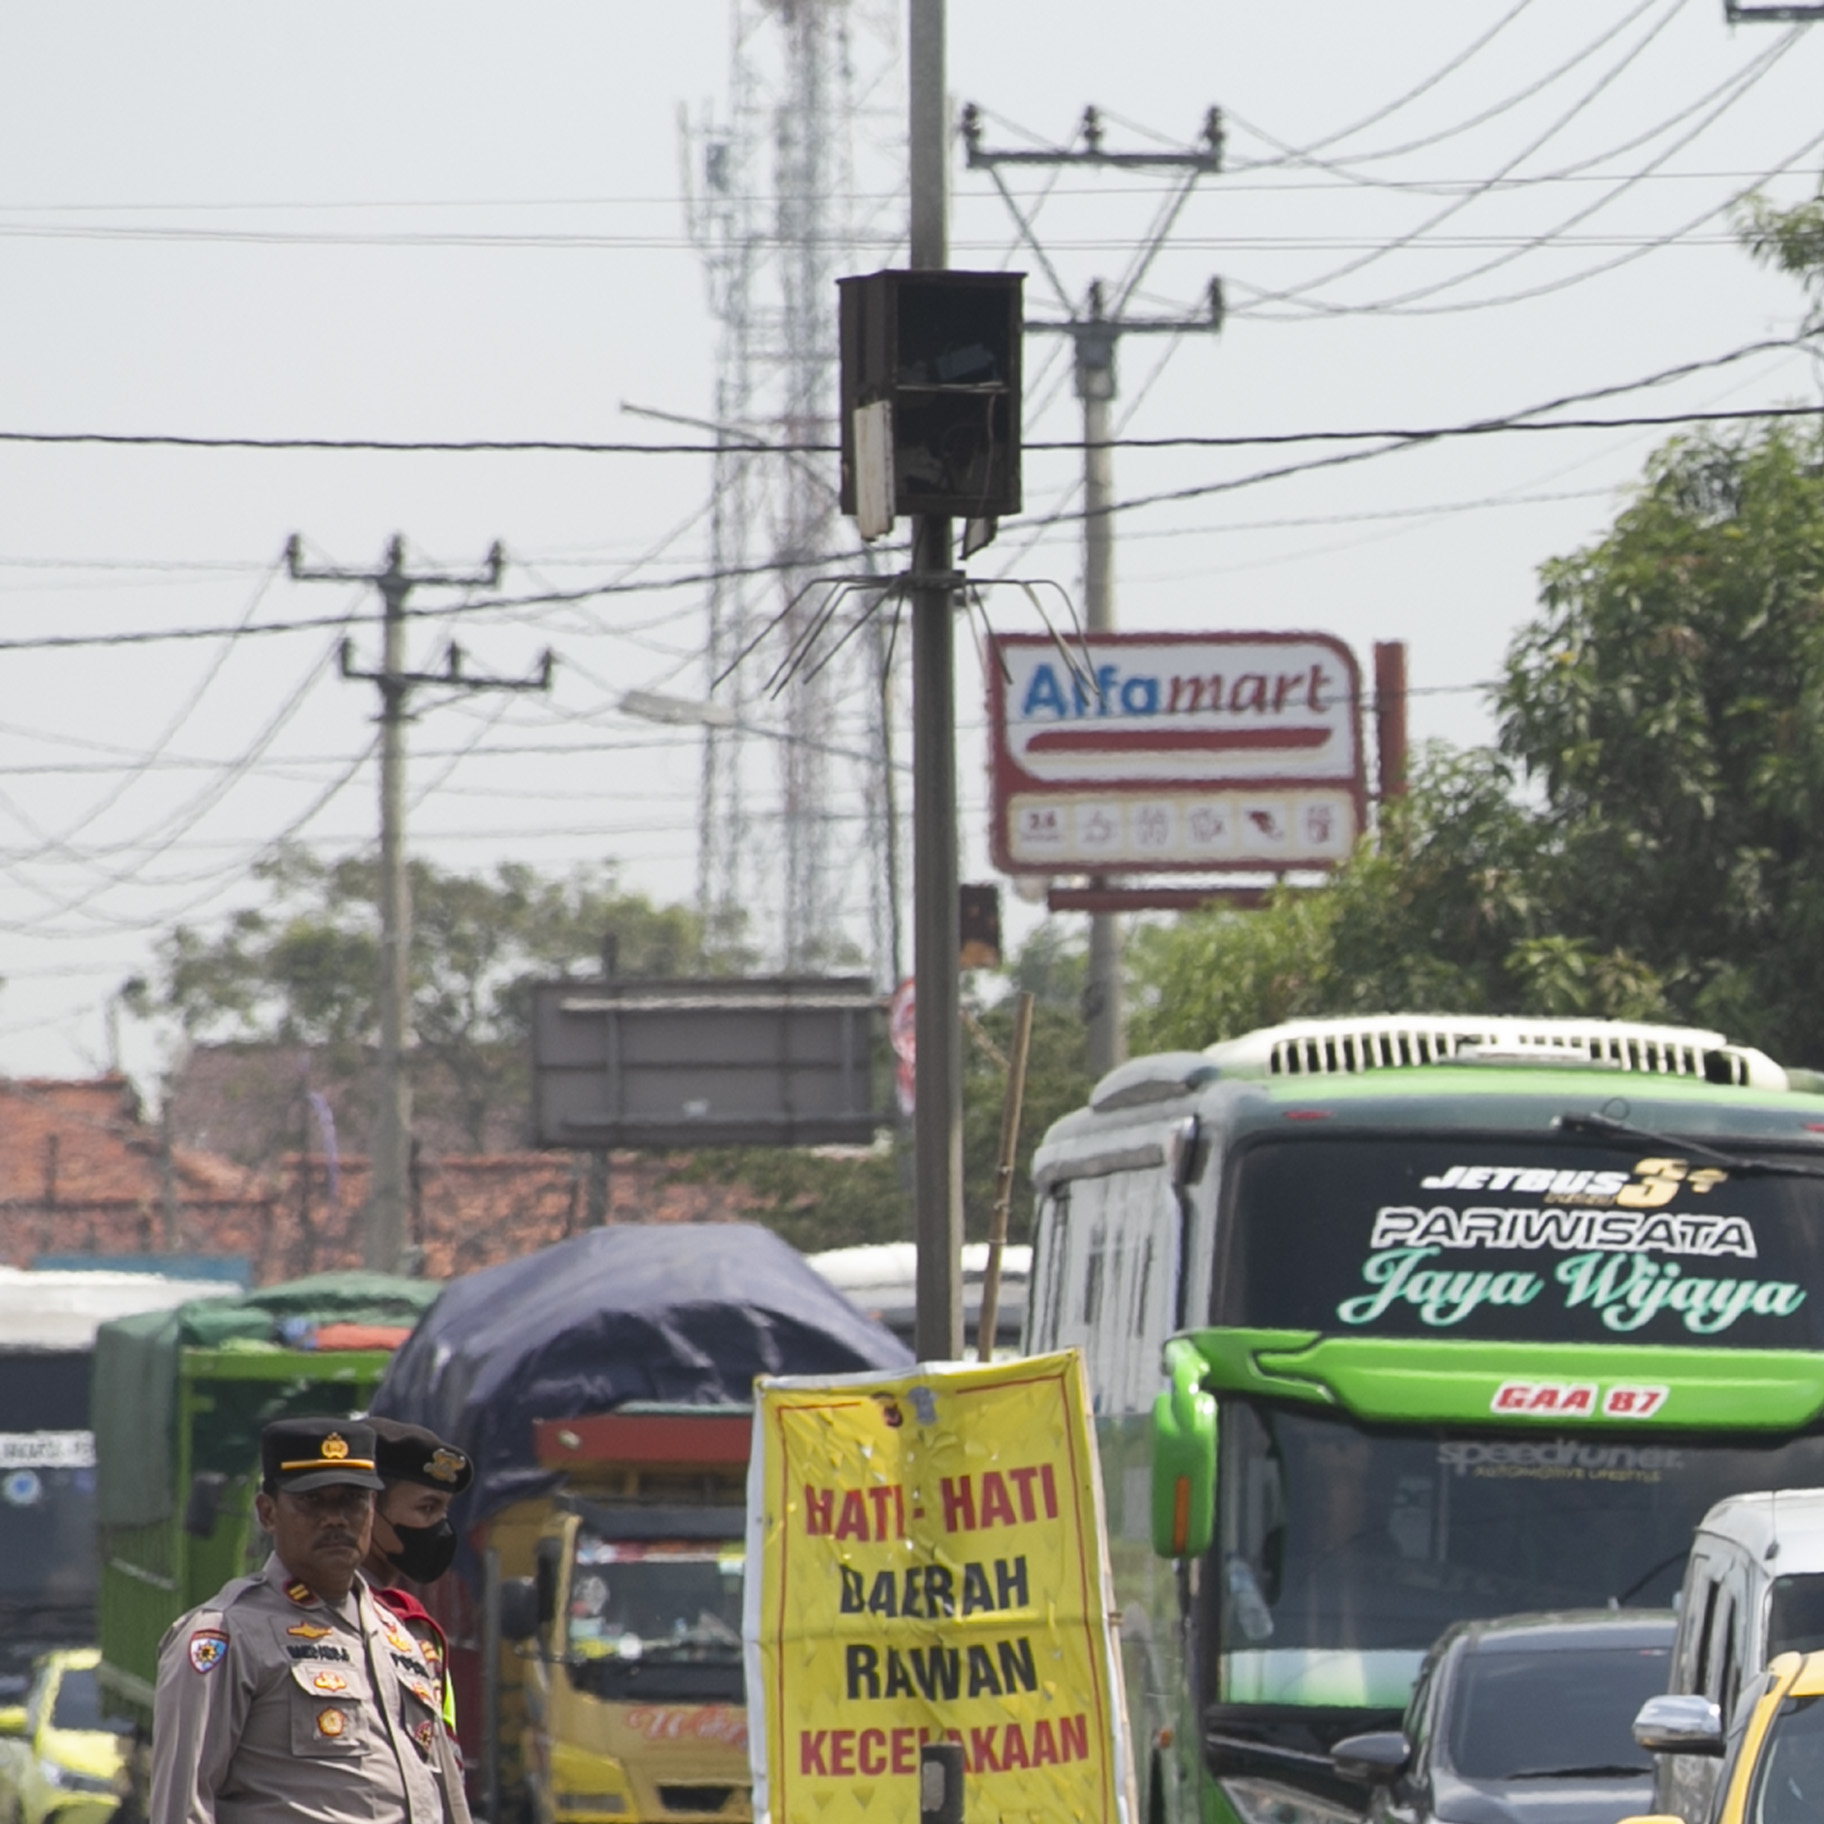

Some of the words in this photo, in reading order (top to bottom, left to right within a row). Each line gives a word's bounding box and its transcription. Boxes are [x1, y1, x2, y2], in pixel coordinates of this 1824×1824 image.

[1371, 1207, 1758, 1258] PARIWISATA
[1336, 1246, 1545, 1327] Jaya
[1556, 1252, 1806, 1333] Wijaya
[1492, 1384, 1592, 1415] GAA
[1606, 1385, 1666, 1415] 87
[804, 1483, 906, 1543] HATI
[940, 1463, 1059, 1534] HATI
[840, 1556, 1029, 1620] DAERAH
[845, 1636, 1038, 1702] RAWAN
